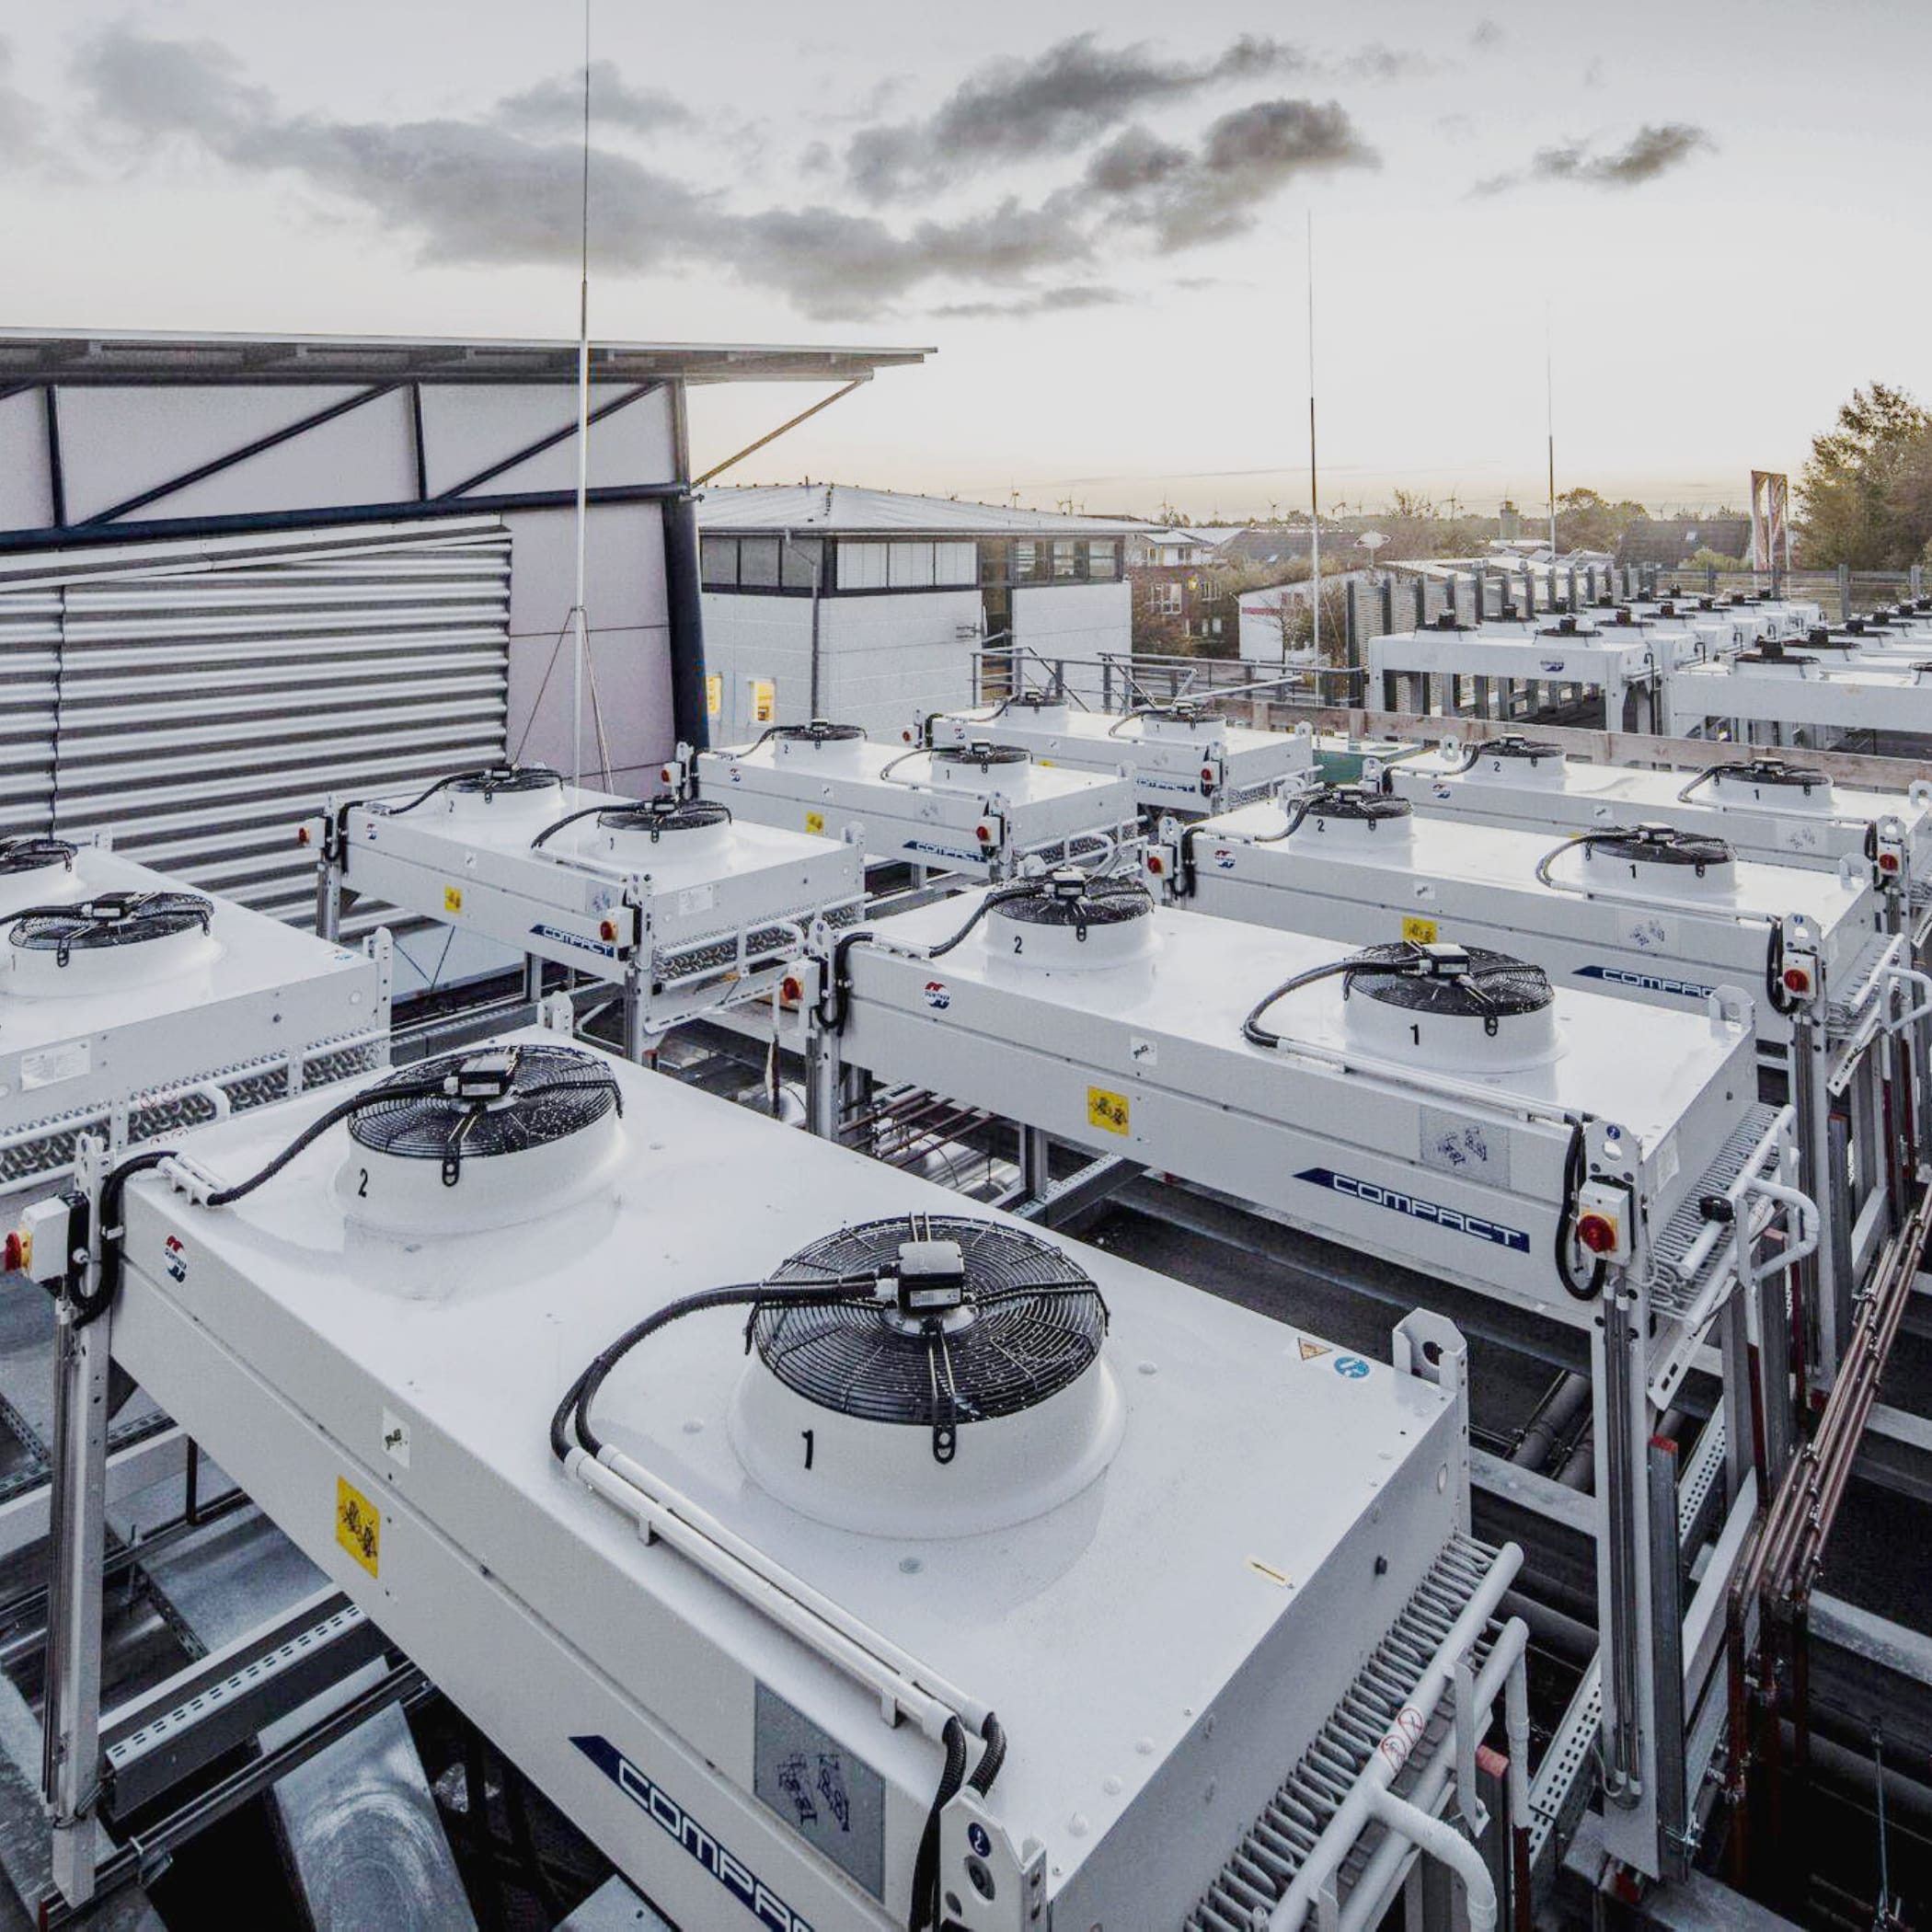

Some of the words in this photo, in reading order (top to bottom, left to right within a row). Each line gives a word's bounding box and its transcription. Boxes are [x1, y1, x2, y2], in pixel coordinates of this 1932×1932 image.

[1493, 761, 1501, 772] 2
[1754, 788, 1760, 799] 1
[1317, 819, 1325, 833] 2
[1629, 864, 1637, 879] 1
[1014, 936, 1022, 954] 2
[1409, 1024, 1420, 1046] 1
[358, 1167, 368, 1198] 2
[1333, 1174, 1522, 1246] COMPACT
[801, 1428, 814, 1470] 1
